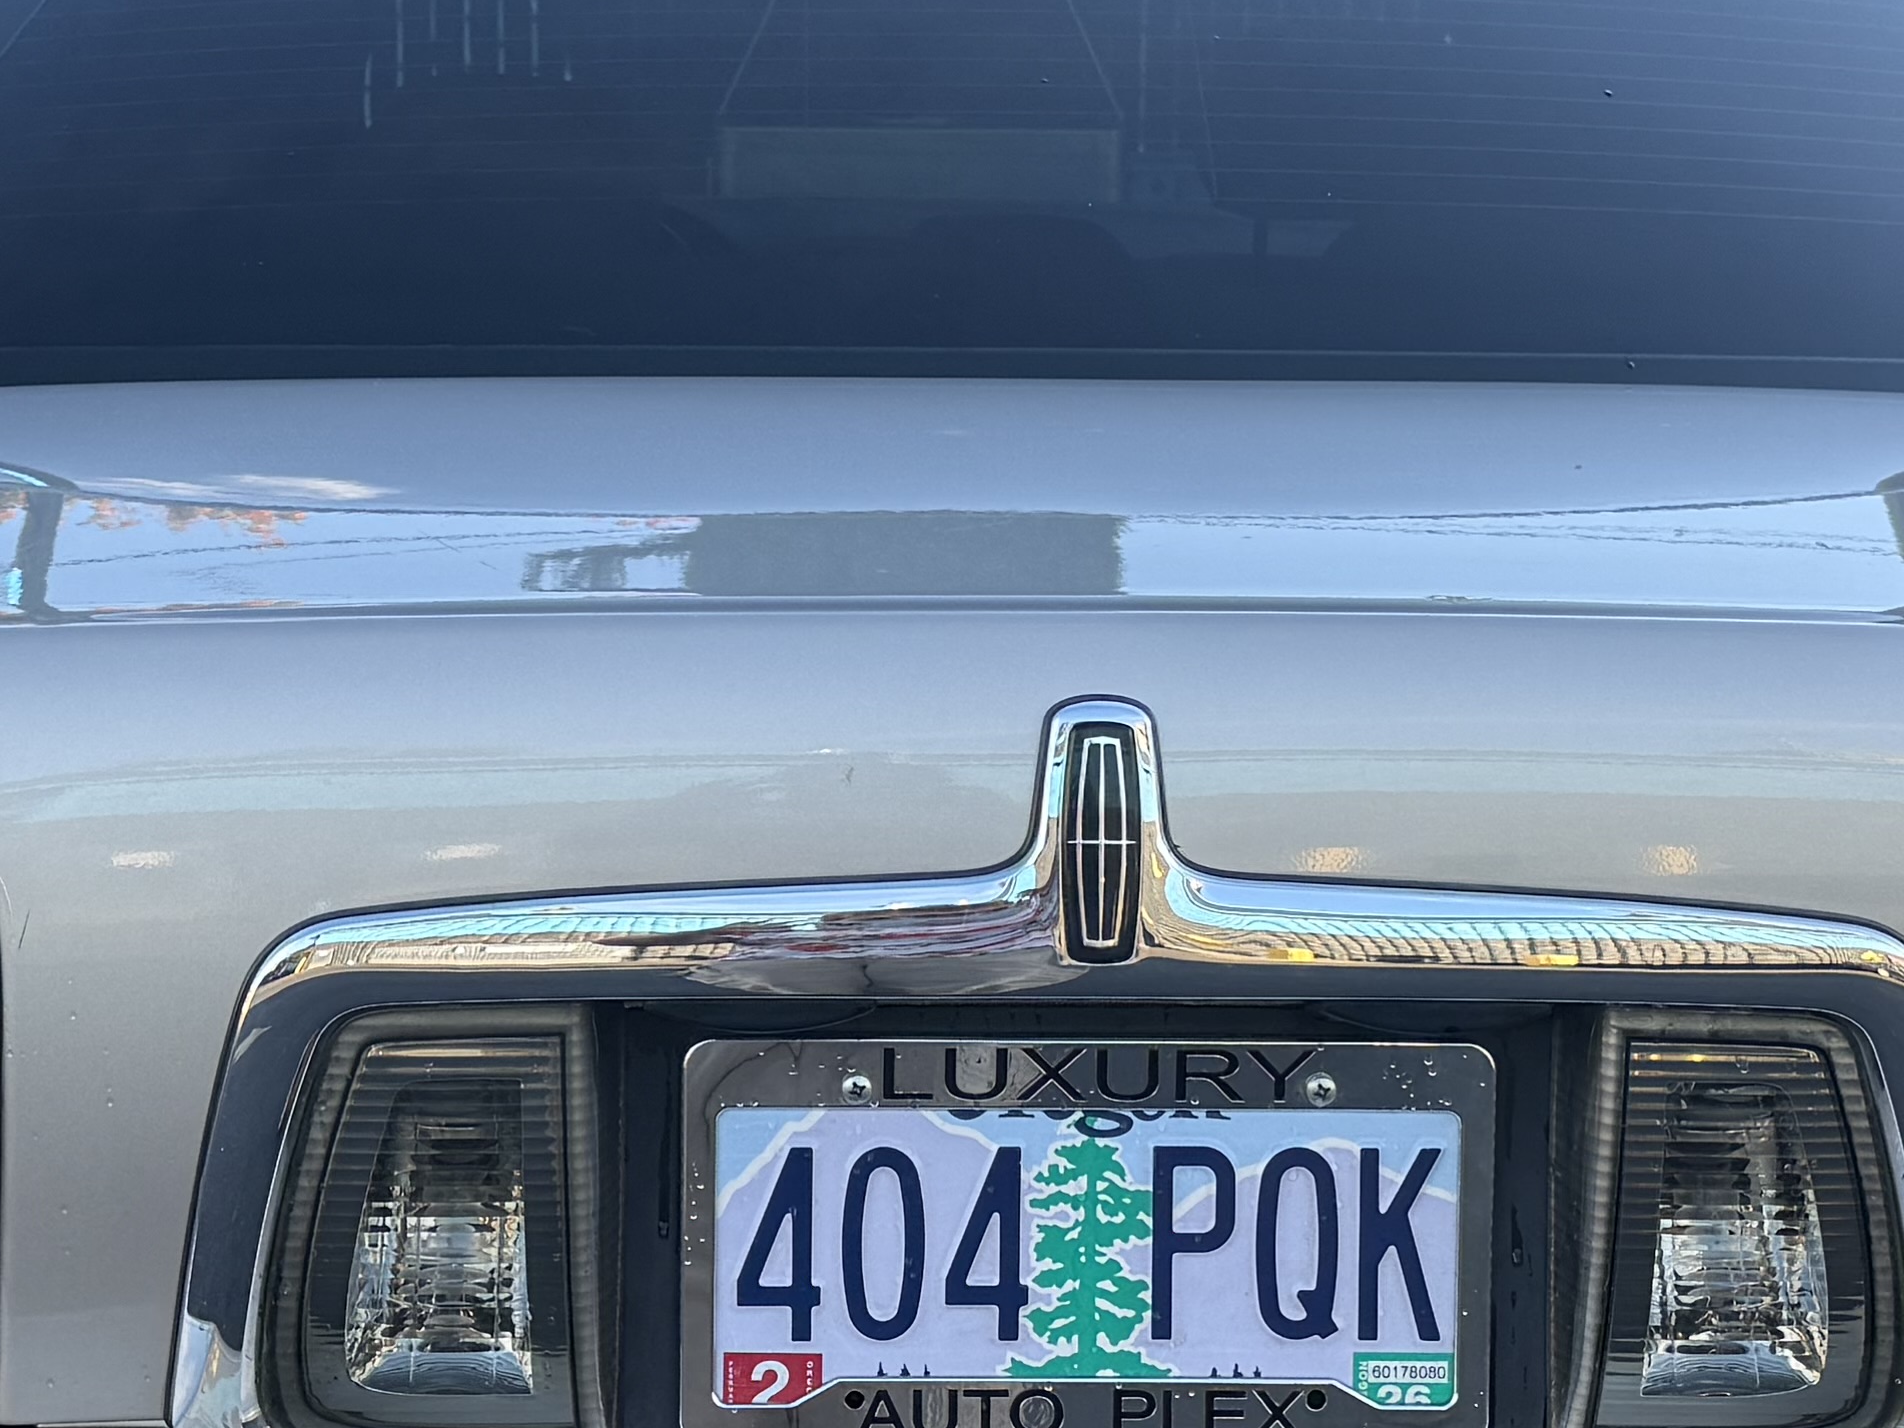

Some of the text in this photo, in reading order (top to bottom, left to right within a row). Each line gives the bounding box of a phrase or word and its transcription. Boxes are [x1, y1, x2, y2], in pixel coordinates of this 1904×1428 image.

[882, 1047, 1316, 1103] LUXURY
[736, 1146, 1441, 1342] 404 PQK
[751, 1360, 790, 1404] 2
[1372, 1365, 1446, 1379] 60178080
